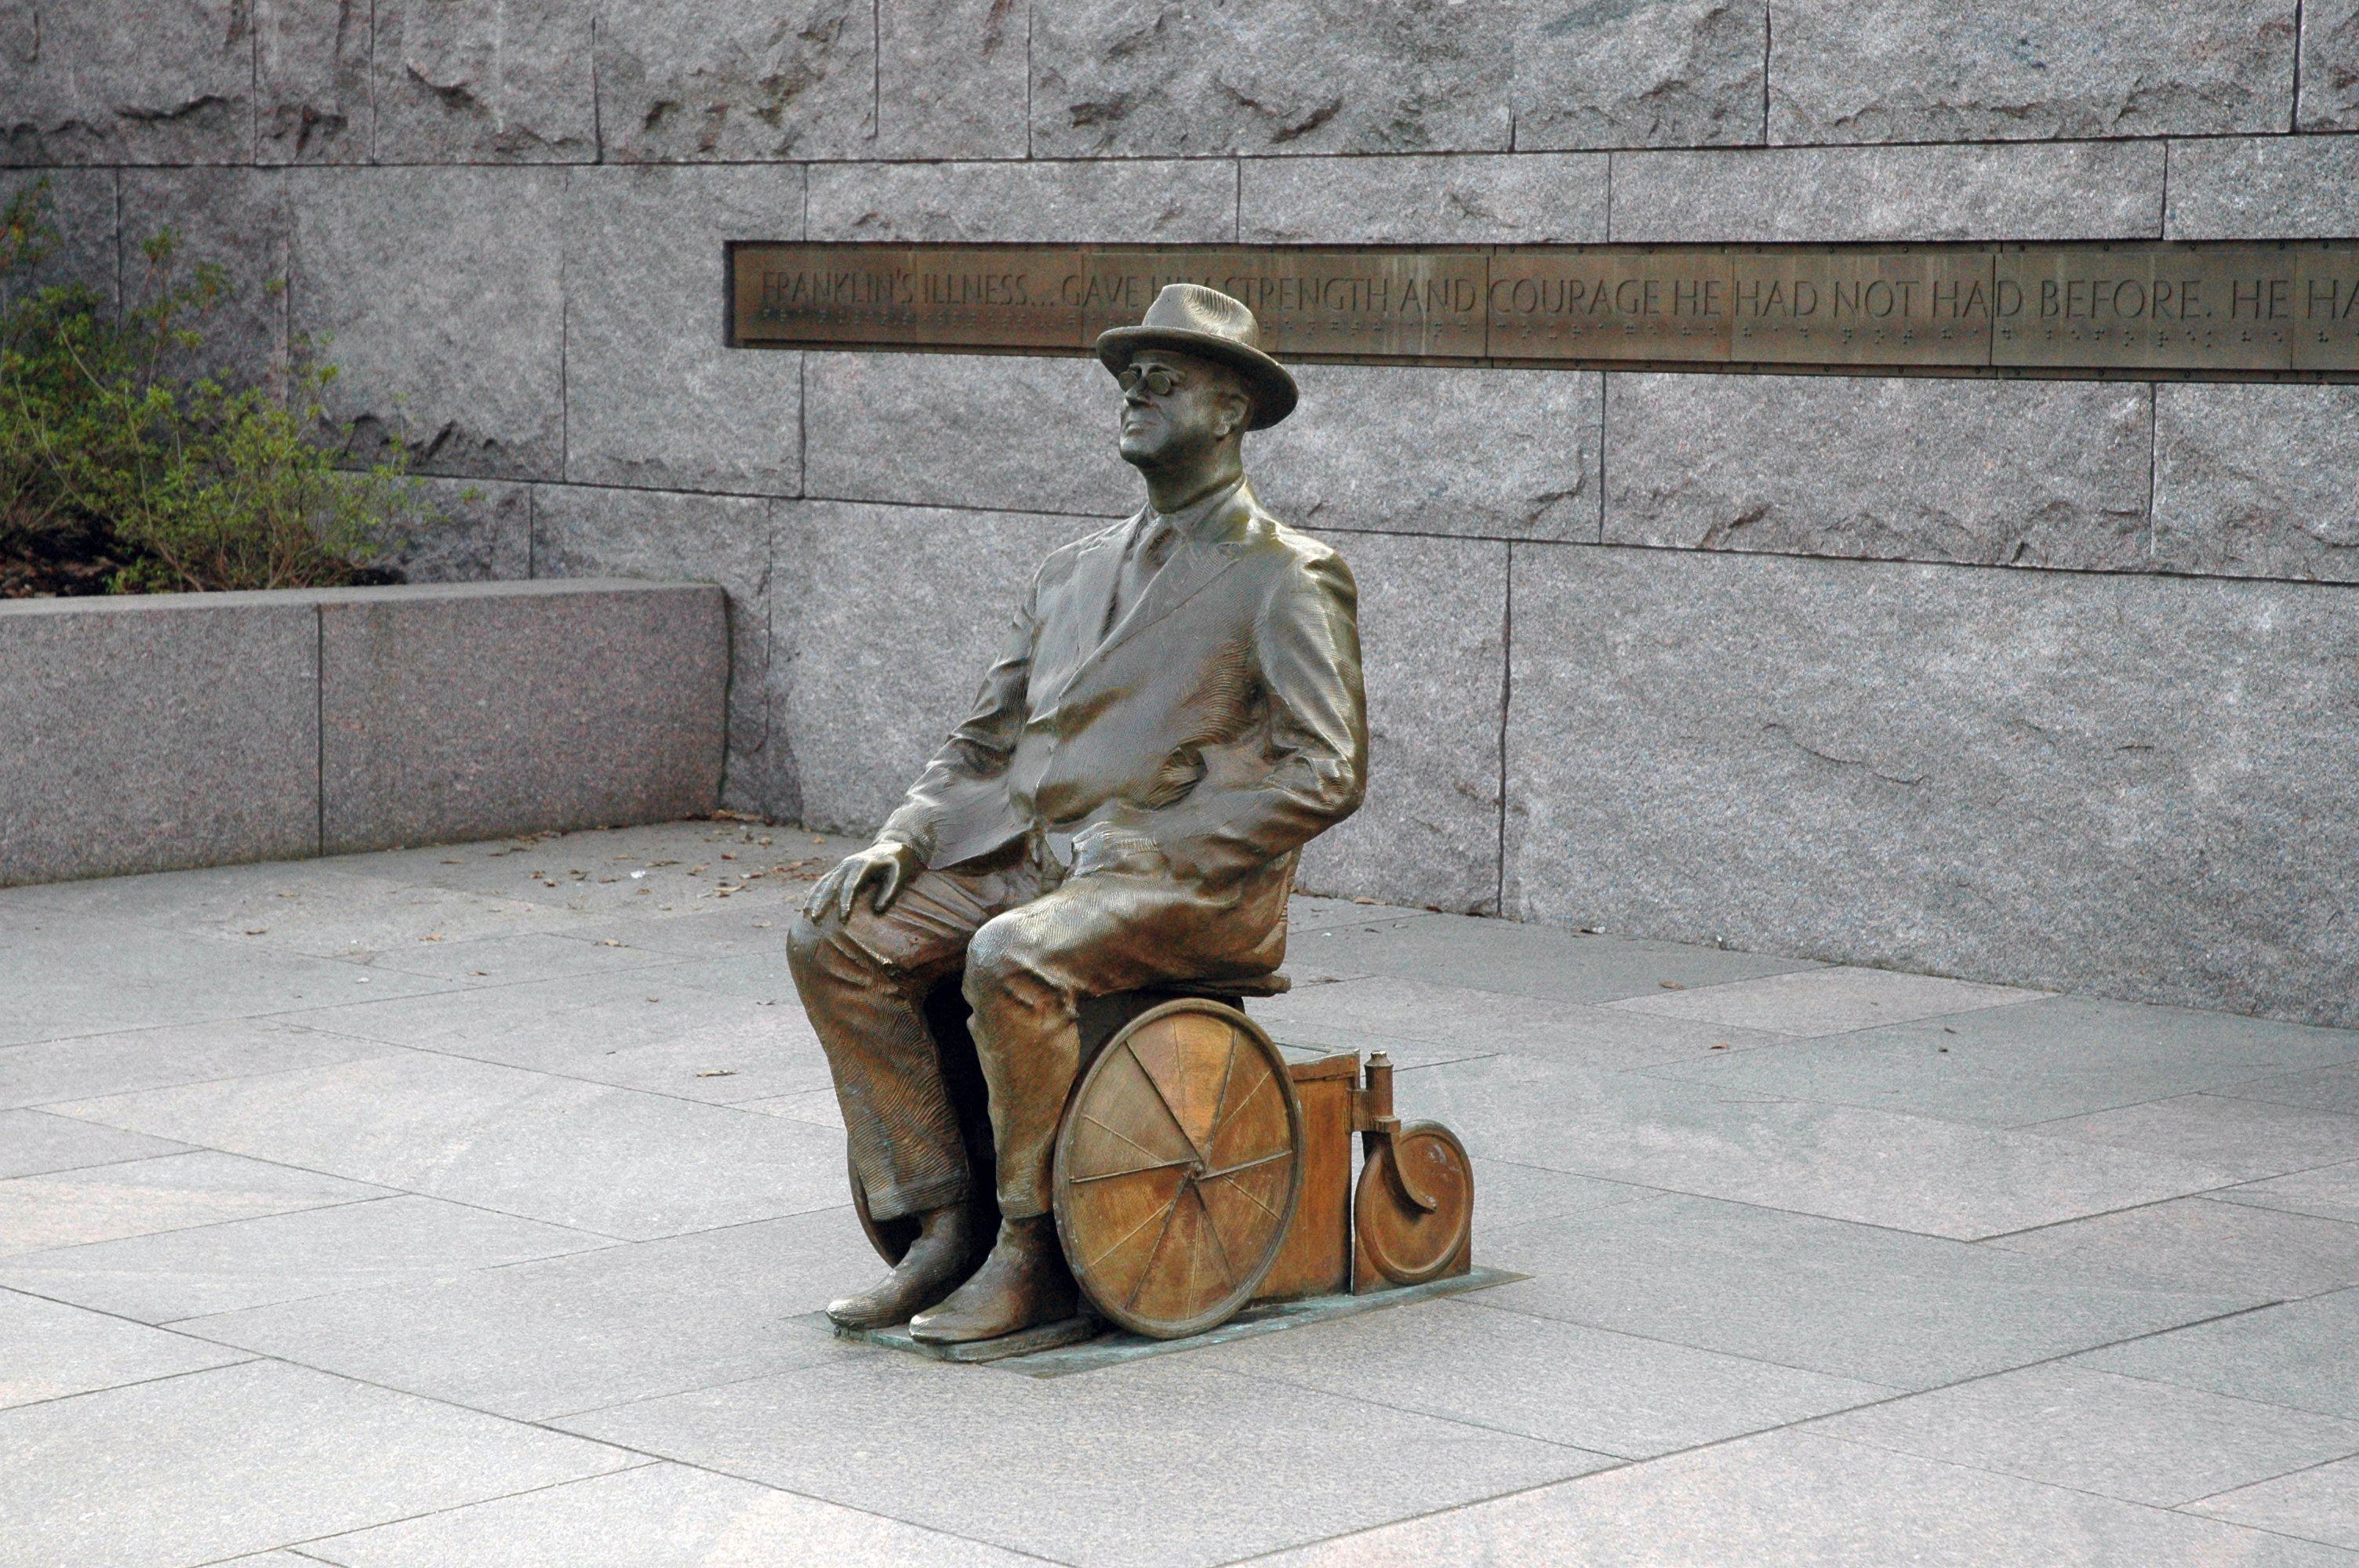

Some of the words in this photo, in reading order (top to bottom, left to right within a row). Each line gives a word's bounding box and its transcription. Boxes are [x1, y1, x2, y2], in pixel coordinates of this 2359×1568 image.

[761, 268, 914, 304] FRANKLIN'S
[922, 274, 1056, 307] ILLNESS...
[1062, 274, 1138, 308] GAVE
[1224, 276, 1388, 314] STRENGTH
[1399, 278, 1476, 314] AND
[1490, 278, 1659, 315] COURAGE
[1673, 280, 1722, 316] HE
[1735, 281, 1818, 318] HAD
[1834, 280, 1920, 318] NOT
[1933, 280, 2022, 318] HAD
[2041, 279, 2212, 320] BEFORE.
[2232, 279, 2288, 320] HE
